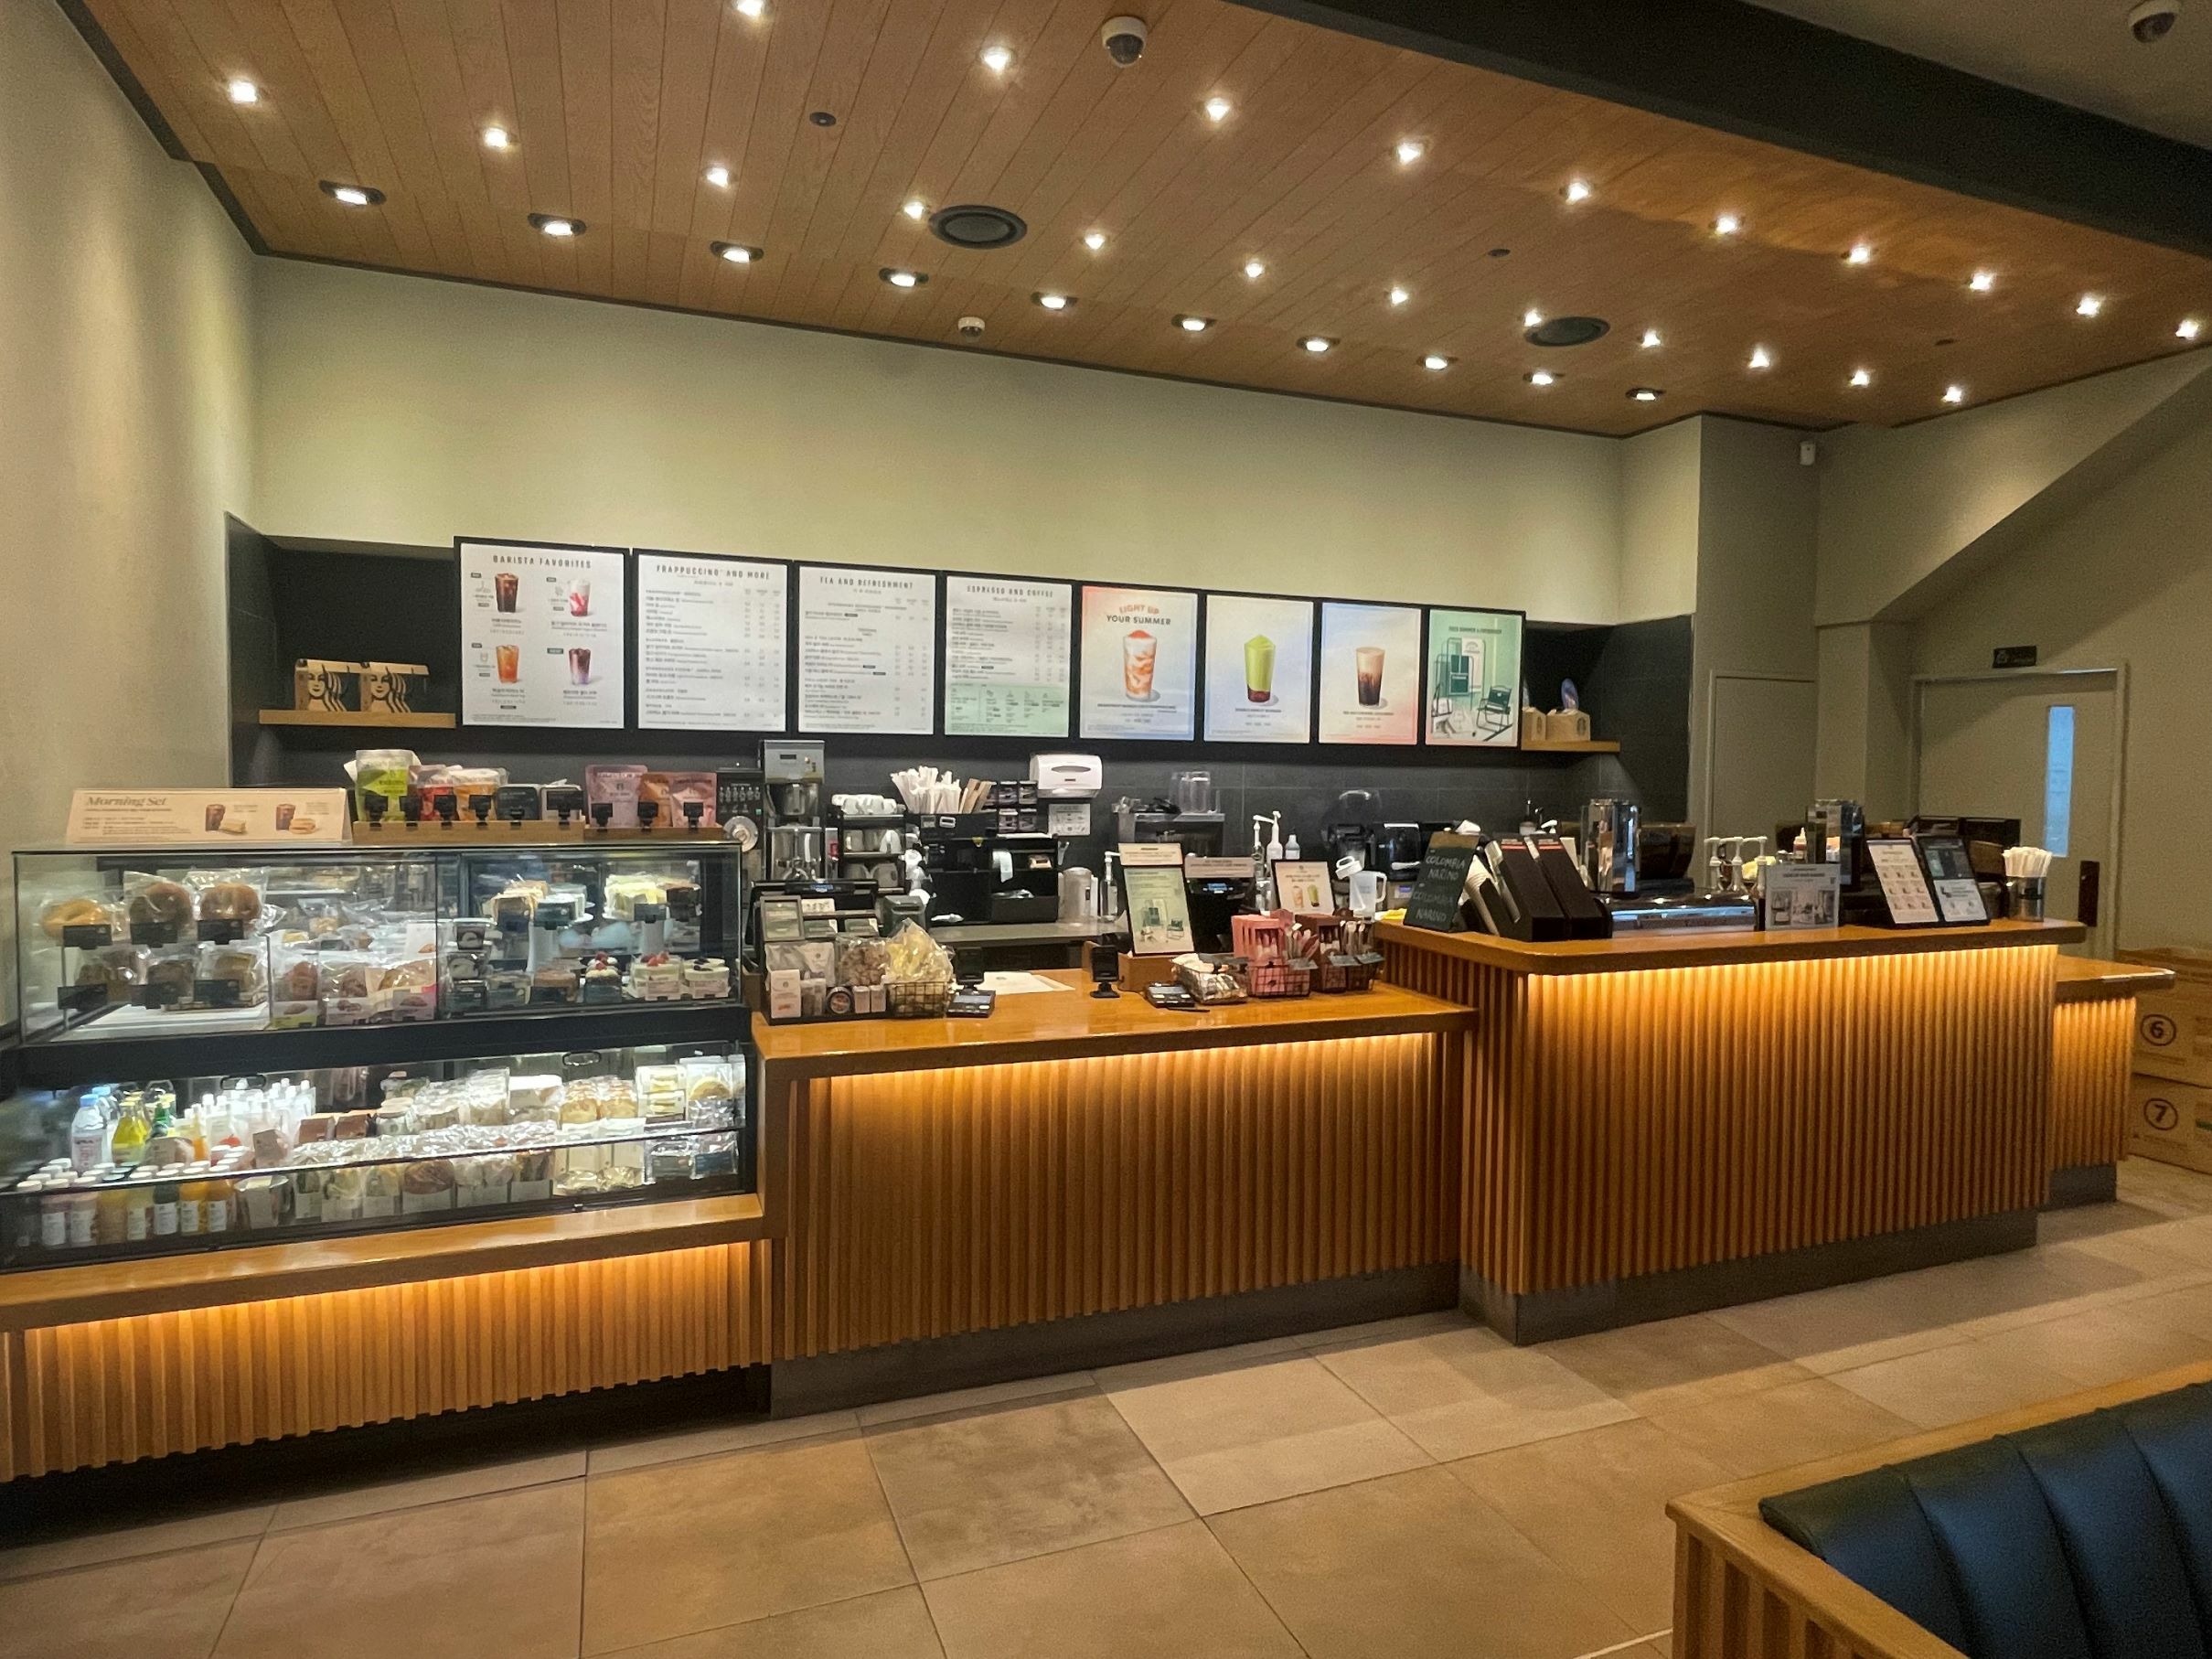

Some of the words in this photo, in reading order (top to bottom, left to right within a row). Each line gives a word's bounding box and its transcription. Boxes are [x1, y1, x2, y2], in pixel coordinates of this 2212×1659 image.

[493, 555, 535, 564] BARISTA
[540, 558, 592, 569] FAVORITES
[726, 570, 743, 578] AND
[747, 571, 770, 580] MORE
[838, 577, 854, 586] AND
[1118, 605, 1145, 614] LIGHT
[1106, 615, 1131, 623] YOUR
[1133, 616, 1171, 626] SUMMER
[86, 797, 145, 807] Morning
[147, 797, 167, 806] Set
[1426, 856, 1465, 870] COLOMBIA
